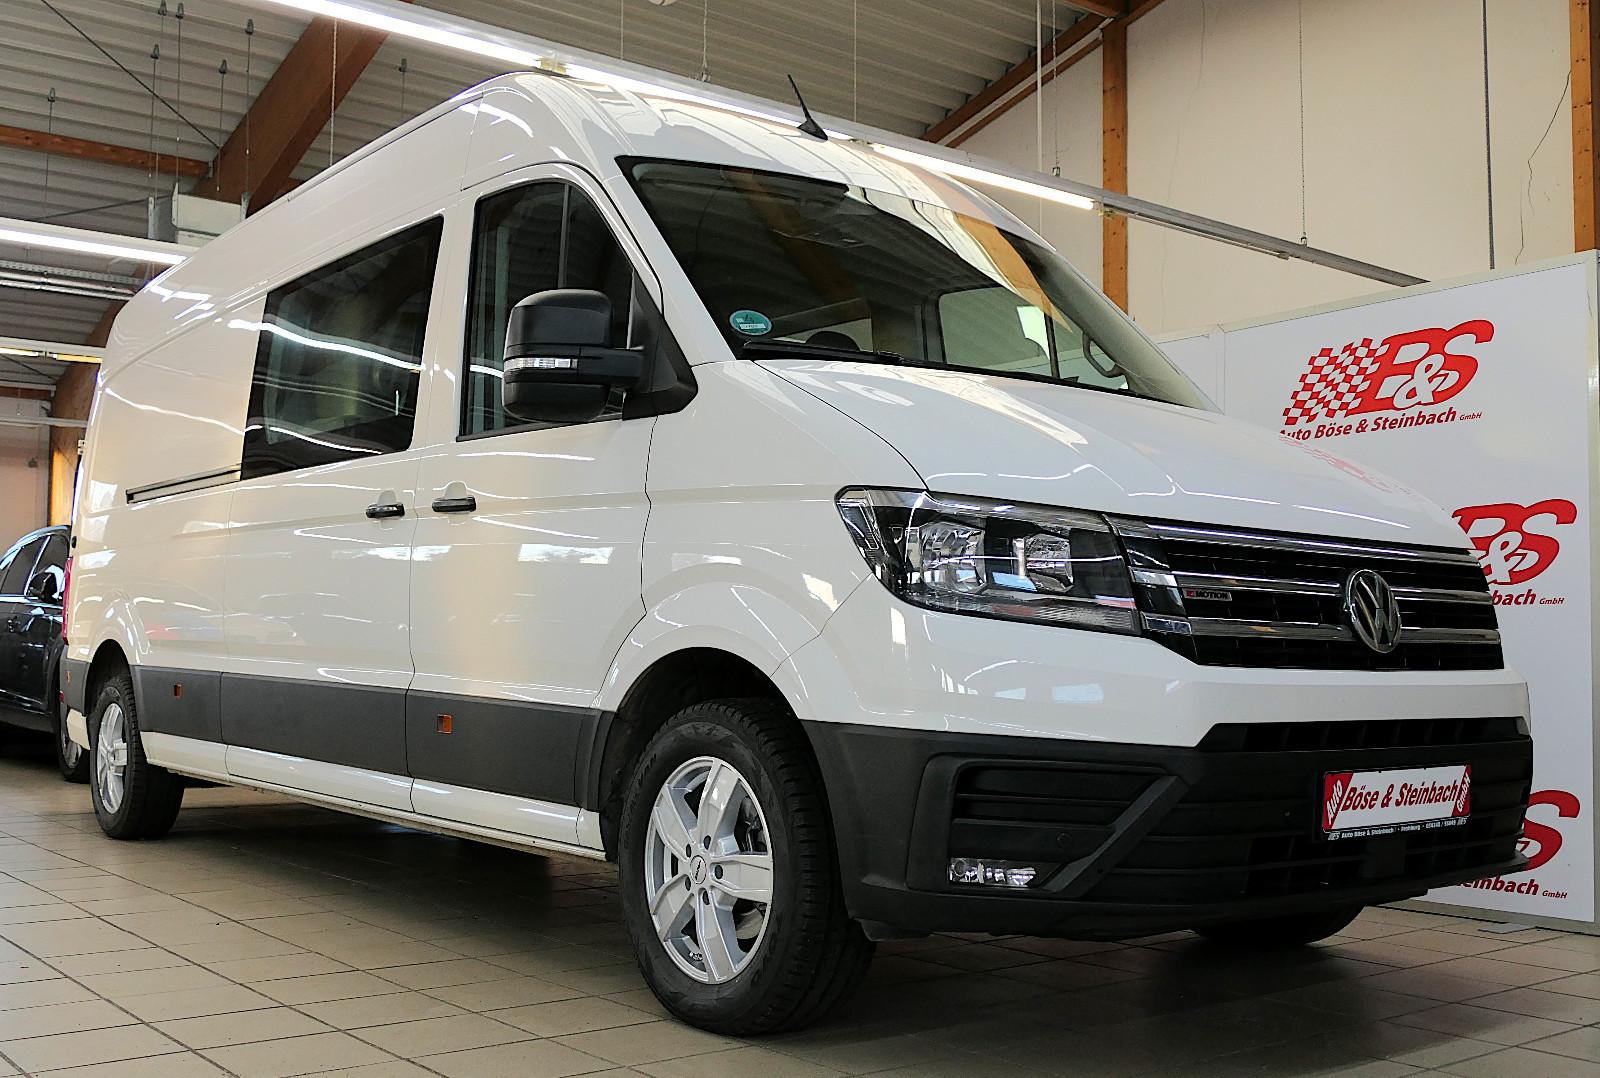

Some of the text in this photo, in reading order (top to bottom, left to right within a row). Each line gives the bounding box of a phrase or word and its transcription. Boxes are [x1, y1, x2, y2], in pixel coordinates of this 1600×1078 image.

[1314, 423, 1352, 439] Böse
[1355, 419, 1368, 434] &
[1370, 407, 1457, 432] Steinbach
[1459, 412, 1482, 421] GmbH
[1539, 597, 1565, 605] GmbH
[1326, 779, 1343, 825] Auto
[1341, 779, 1458, 811] Böse & Steinbach
[1456, 875, 1568, 899] inbach GmbH
